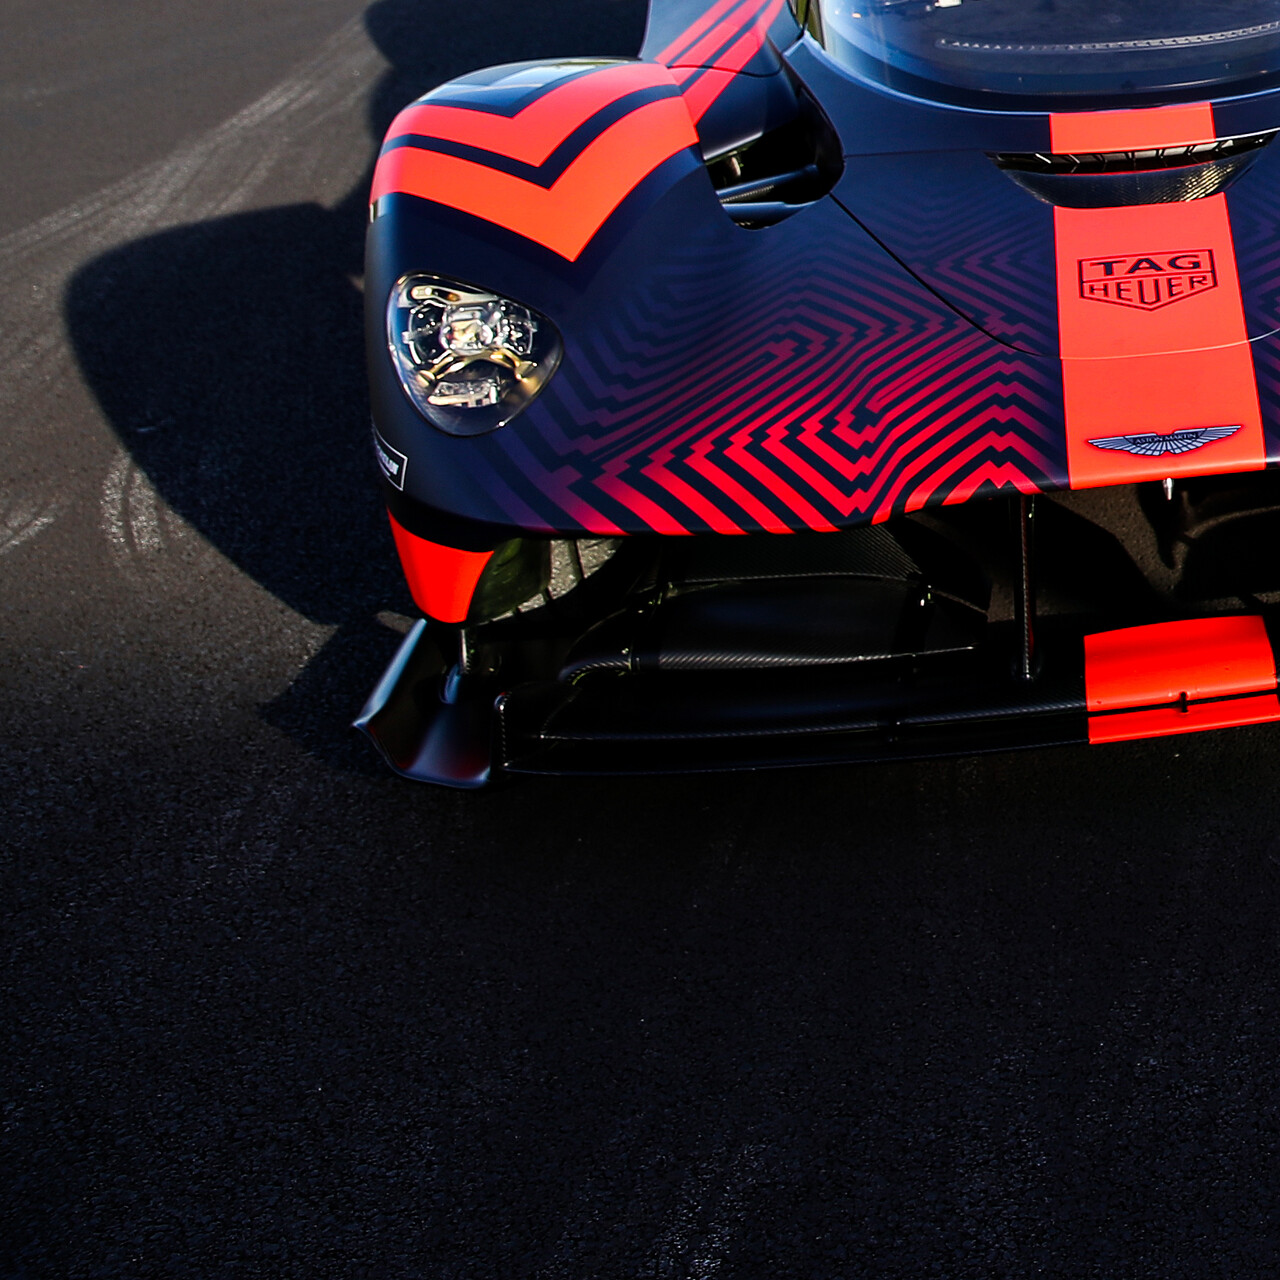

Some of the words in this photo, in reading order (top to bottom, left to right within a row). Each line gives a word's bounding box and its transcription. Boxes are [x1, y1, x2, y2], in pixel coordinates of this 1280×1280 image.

[1089, 254, 1202, 277] TAG
[1088, 275, 1209, 305] HEUER
[1134, 434, 1164, 445] ASTON
[1163, 432, 1198, 442] MARTIN
